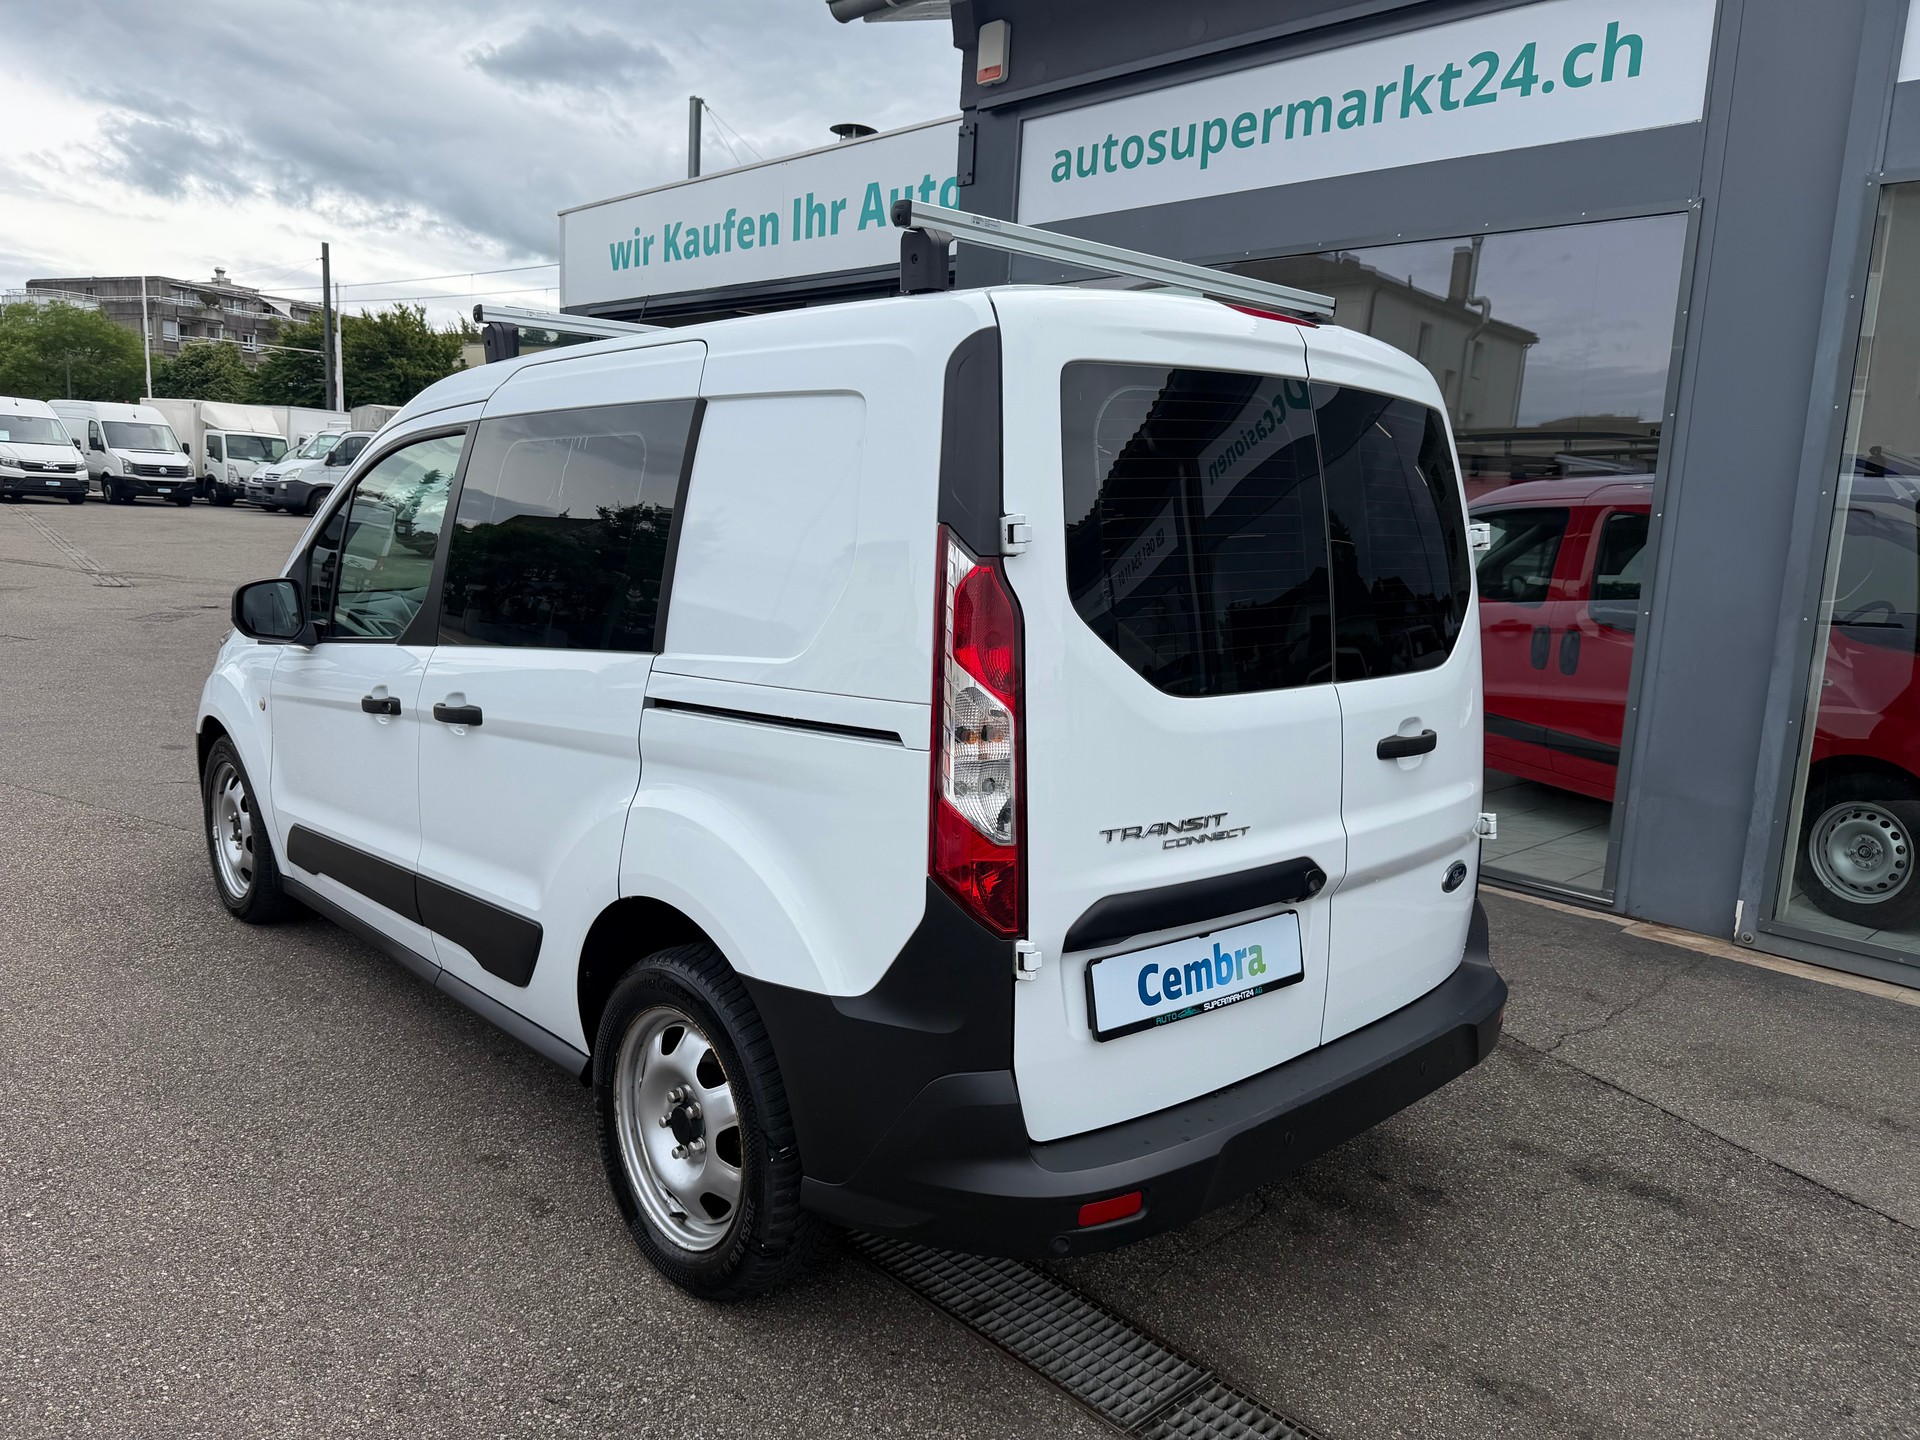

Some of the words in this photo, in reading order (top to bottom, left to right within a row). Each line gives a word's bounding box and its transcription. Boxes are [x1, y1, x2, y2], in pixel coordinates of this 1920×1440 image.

[1051, 21, 1644, 184] autosupermarkt24.ch
[609, 227, 655, 272] wir
[663, 208, 780, 263] Kaufen
[792, 192, 847, 242] Ihr
[1098, 812, 1229, 844] TRANSIT
[1161, 825, 1251, 850] CONNECT
[1137, 942, 1267, 1007] Cembra
[1155, 1012, 1178, 1026] AUTO
[1255, 986, 1264, 997] AG
